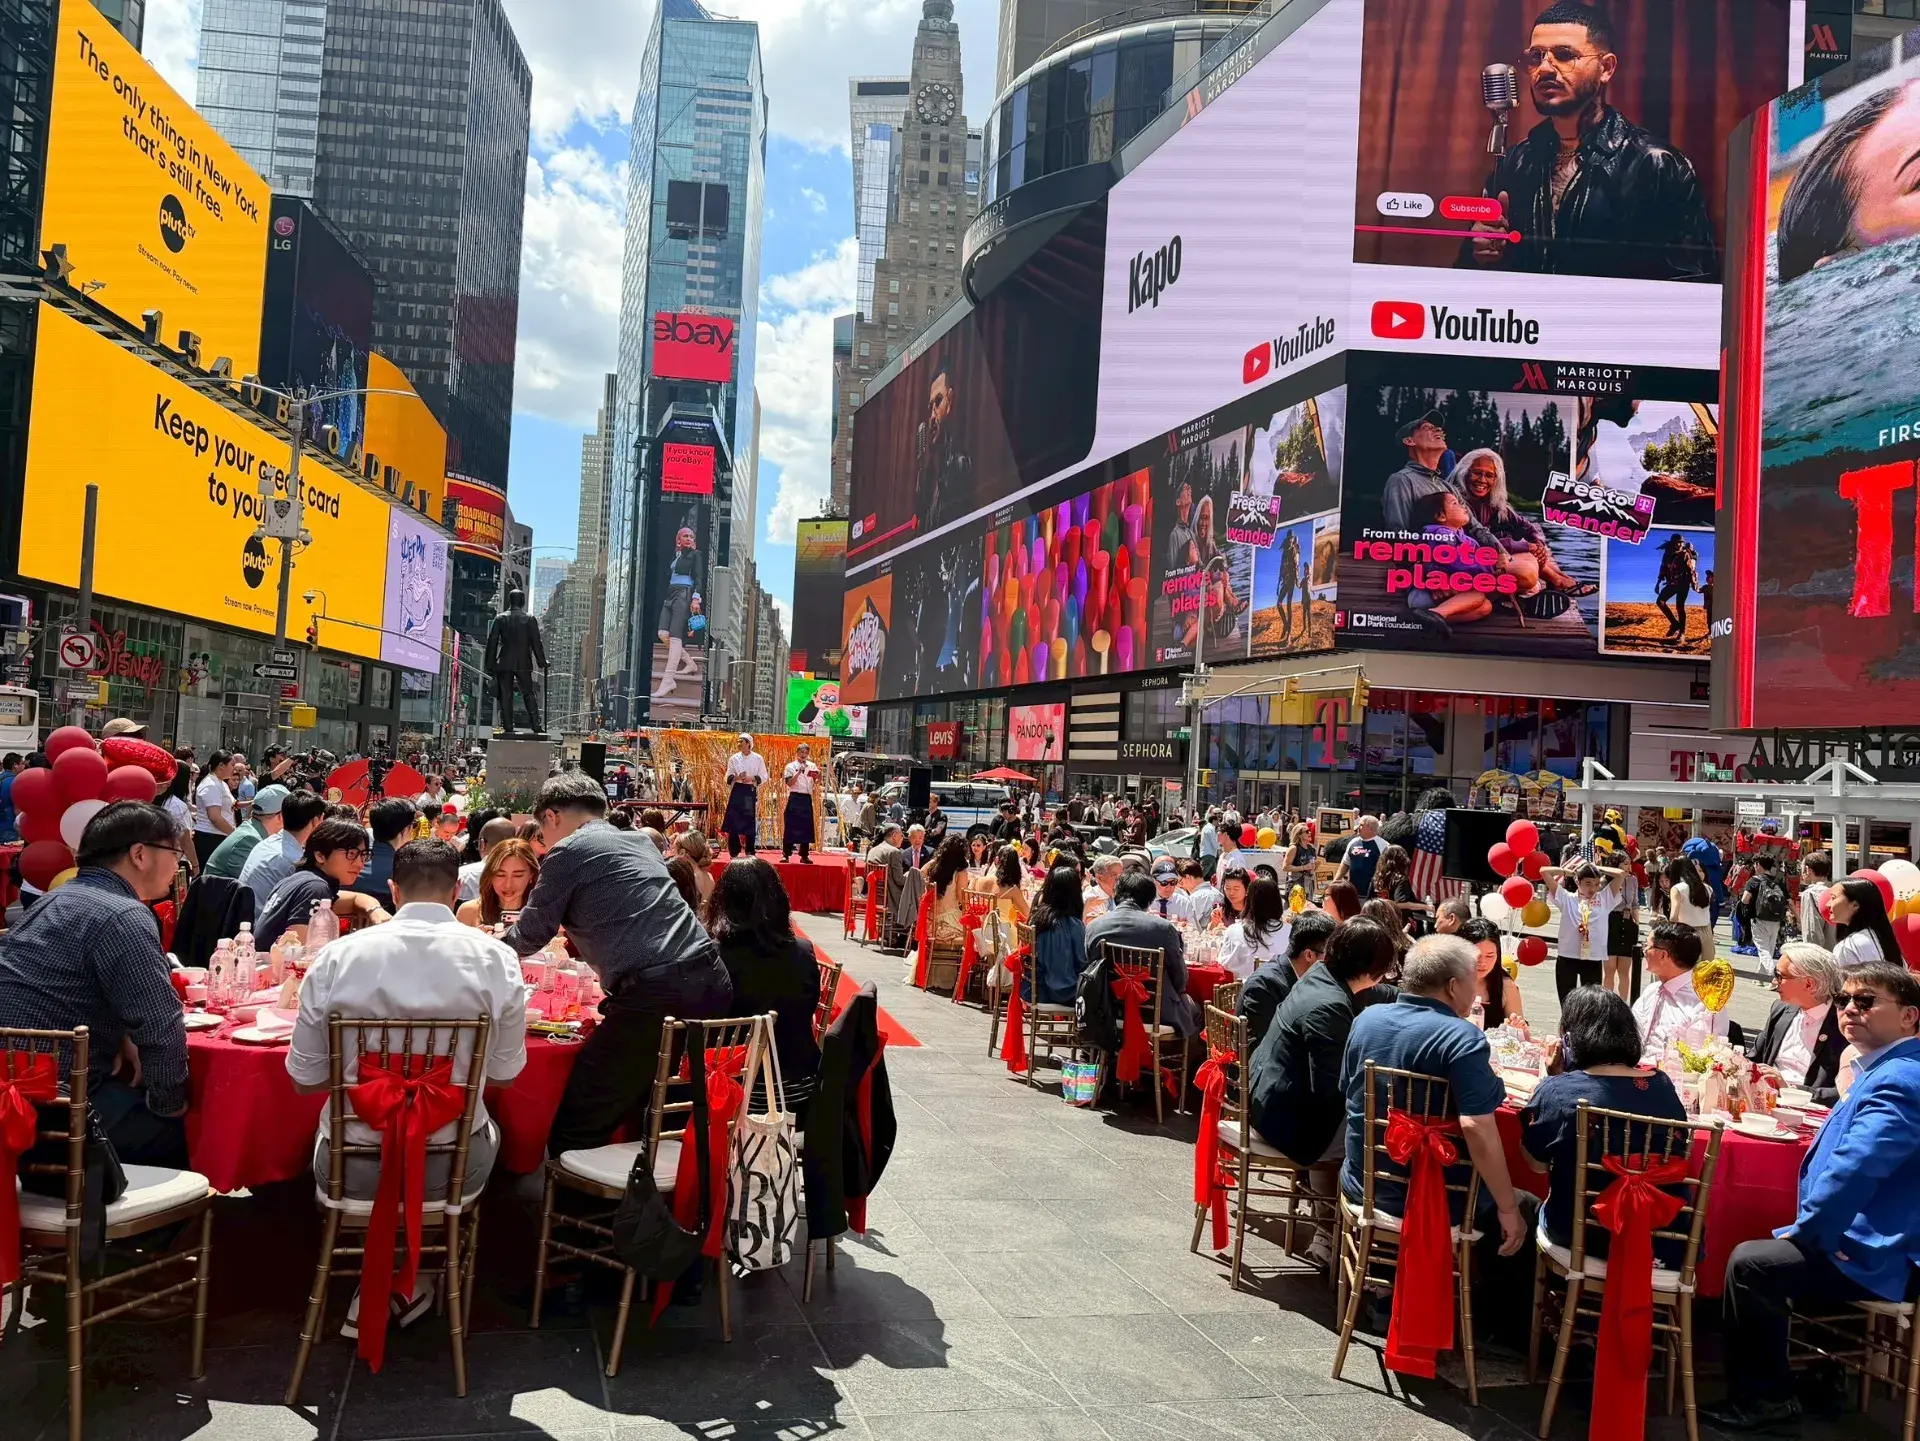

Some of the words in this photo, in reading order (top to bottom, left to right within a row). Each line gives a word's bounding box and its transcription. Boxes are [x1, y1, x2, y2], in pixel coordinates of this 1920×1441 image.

[1208, 33, 1261, 87] MARRIOTT
[1809, 51, 1848, 61] MARRIOTT
[1207, 55, 1254, 102] MARQUIS
[77, 30, 109, 82] The
[113, 75, 146, 119] only
[150, 105, 186, 161] thing
[189, 140, 201, 170] in
[204, 154, 231, 196] New
[234, 181, 258, 223] York
[122, 115, 166, 170] that's
[169, 160, 193, 195] still
[195, 179, 224, 222] free.
[1403, 201, 1423, 210] Like
[1450, 203, 1491, 214] Subscribe
[274, 239, 291, 251] LG
[137, 244, 159, 267] Stream
[159, 260, 172, 278] now.
[172, 269, 184, 288] Pay
[183, 280, 199, 295] never.
[1128, 235, 1182, 314] Kapo
[654, 313, 734, 353] ebay
[1430, 305, 1540, 345] YouTube
[1273, 316, 1335, 369] YouTube
[1557, 366, 1632, 380] MARRIOTT
[1556, 380, 1622, 392] MARQUIS
[1181, 415, 1215, 437] MARRIOTT
[1181, 428, 1210, 447] MARQUIS
[154, 394, 208, 457] Keep
[215, 435, 254, 475] your
[308, 486, 340, 519] card
[673, 448, 688, 456] you
[208, 472, 228, 506] to
[1549, 474, 1602, 501] Free
[1604, 489, 1628, 506] to
[1230, 492, 1255, 511] Free
[1256, 498, 1268, 512] to
[1363, 528, 1395, 538] From
[1398, 528, 1420, 540] the
[1422, 531, 1455, 542] most
[1545, 506, 1646, 544] wander
[1228, 527, 1274, 547] wander
[1353, 540, 1499, 566] remote
[1165, 569, 1176, 578] From
[1184, 564, 1196, 573] most
[1387, 563, 1518, 595] places
[1162, 570, 1211, 596] remote
[224, 596, 242, 609] Stream
[242, 602, 254, 612] now.
[253, 604, 262, 616] Pay
[262, 609, 275, 618] never.
[1367, 614, 1397, 622] National
[1384, 622, 1422, 630] Foundation
[260, 667, 272, 675] ONE
[1141, 677, 1169, 687] SEPHORA
[1123, 743, 1173, 758] SEPHORA
[1717, 771, 1726, 779] 46
